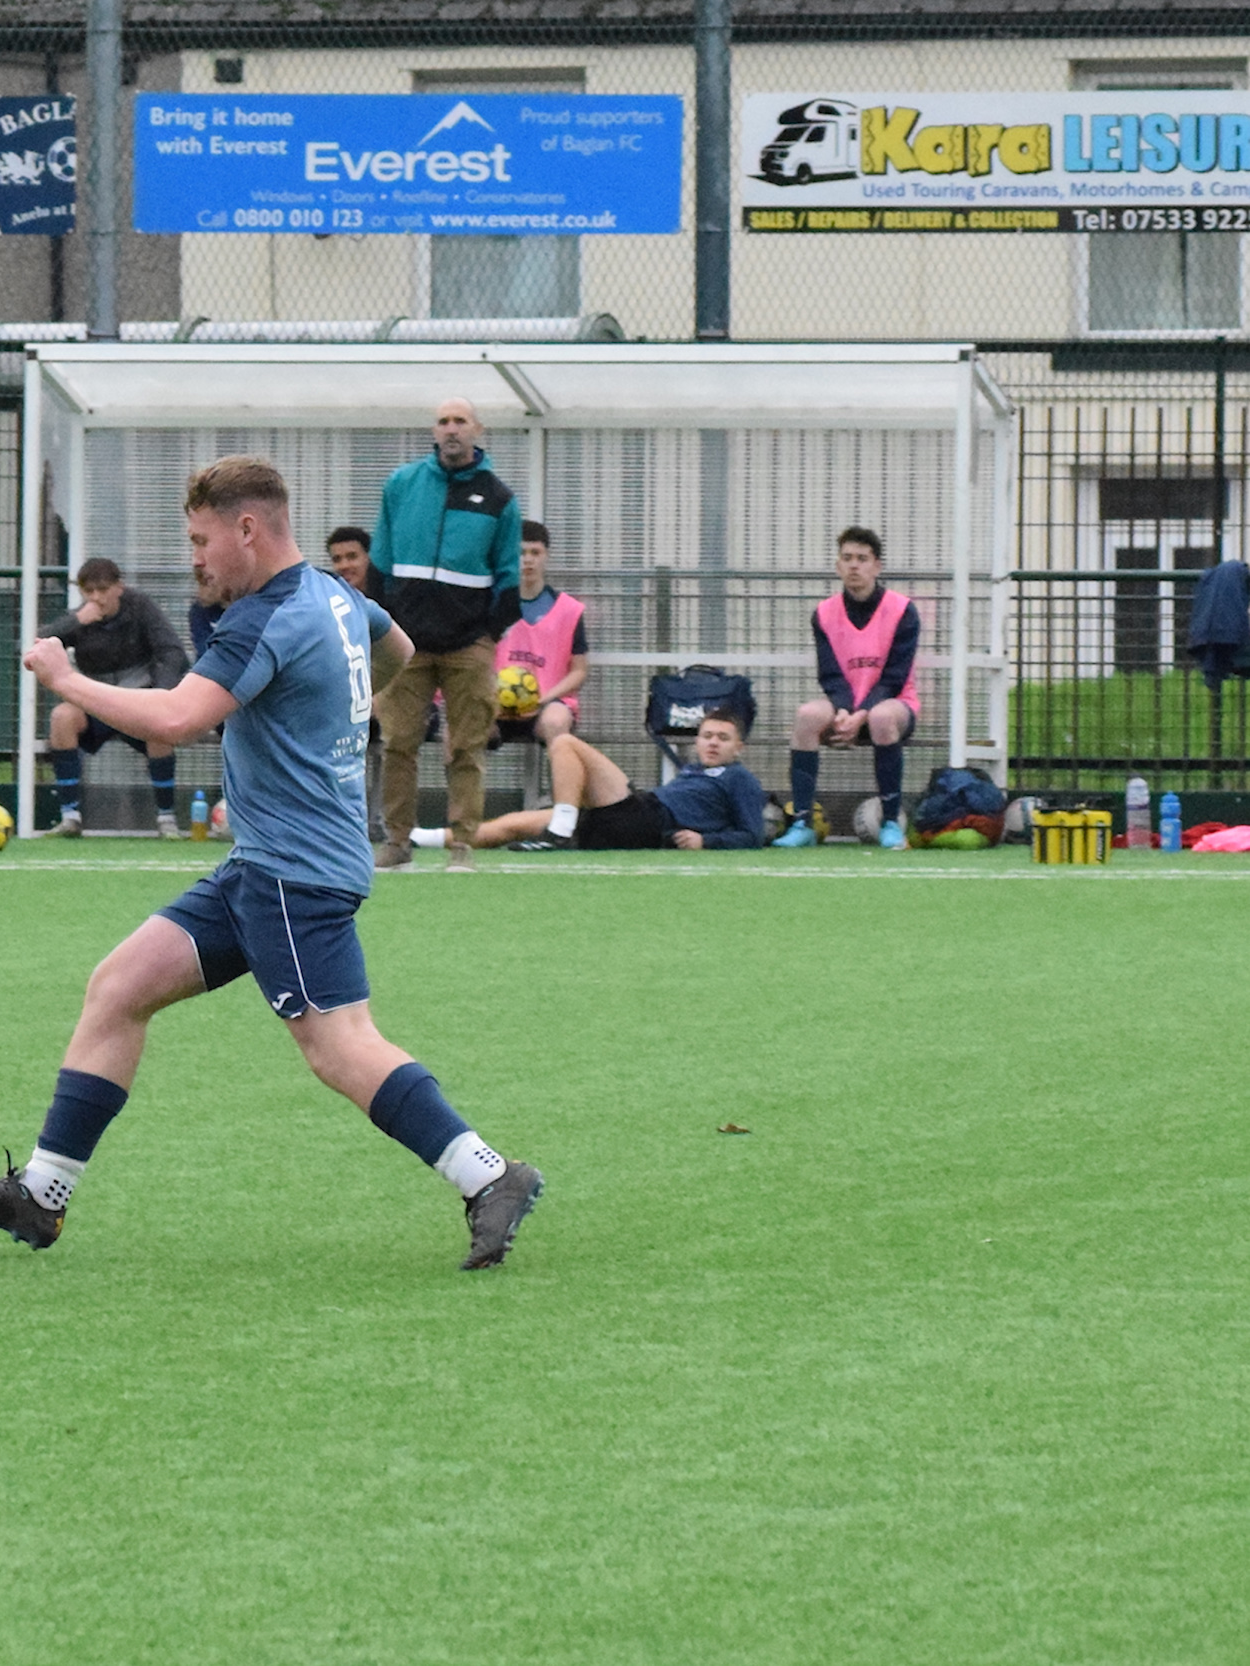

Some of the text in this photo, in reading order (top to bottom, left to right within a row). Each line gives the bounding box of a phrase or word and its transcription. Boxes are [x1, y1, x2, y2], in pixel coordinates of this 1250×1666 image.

[150, 107, 294, 131] Bring it home
[520, 107, 665, 129] Proud supporters
[156, 138, 288, 156] with Everest
[540, 135, 559, 152] of
[618, 134, 643, 152] FC
[860, 105, 1053, 178] Kara
[304, 141, 512, 183] Everest
[862, 181, 1250, 201] Used Touring Caravans, Motorhomes & Cam
[196, 209, 229, 228] Call
[233, 207, 285, 228] 0800
[288, 207, 325, 228] 010
[331, 207, 364, 228] 123
[369, 214, 387, 228] or
[430, 209, 617, 228] www.everest.co.uk
[750, 210, 796, 230] SALES
[1072, 208, 1250, 231] Tel: 07533 922
